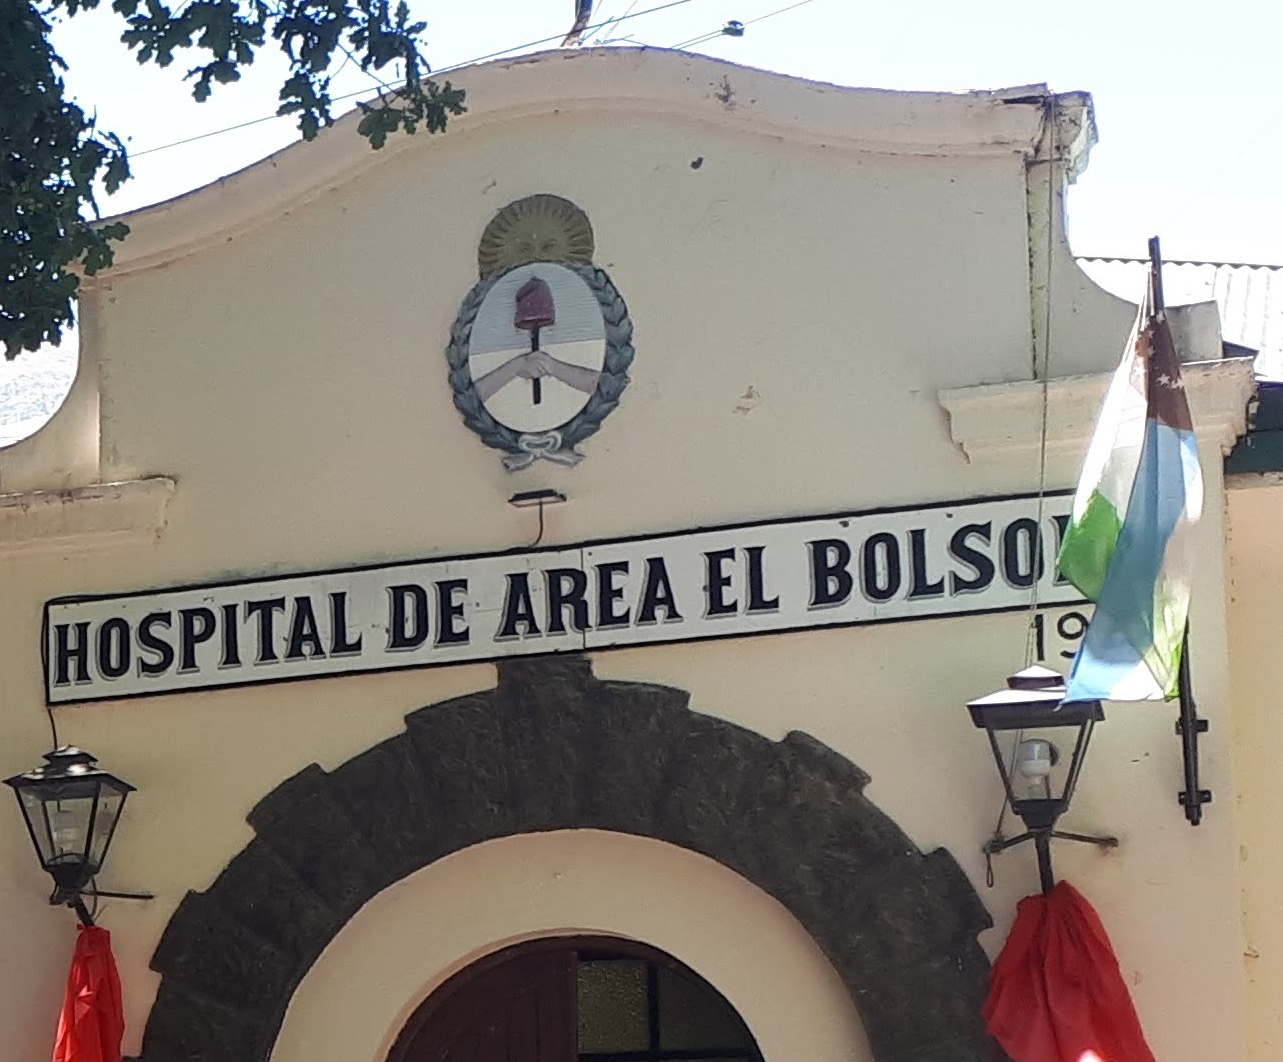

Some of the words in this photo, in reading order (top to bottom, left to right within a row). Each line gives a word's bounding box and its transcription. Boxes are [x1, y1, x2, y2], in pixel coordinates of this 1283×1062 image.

[53, 591, 363, 688] HOSPITAL
[385, 578, 471, 653] DE
[494, 556, 683, 642] AREA
[700, 545, 780, 620] EL
